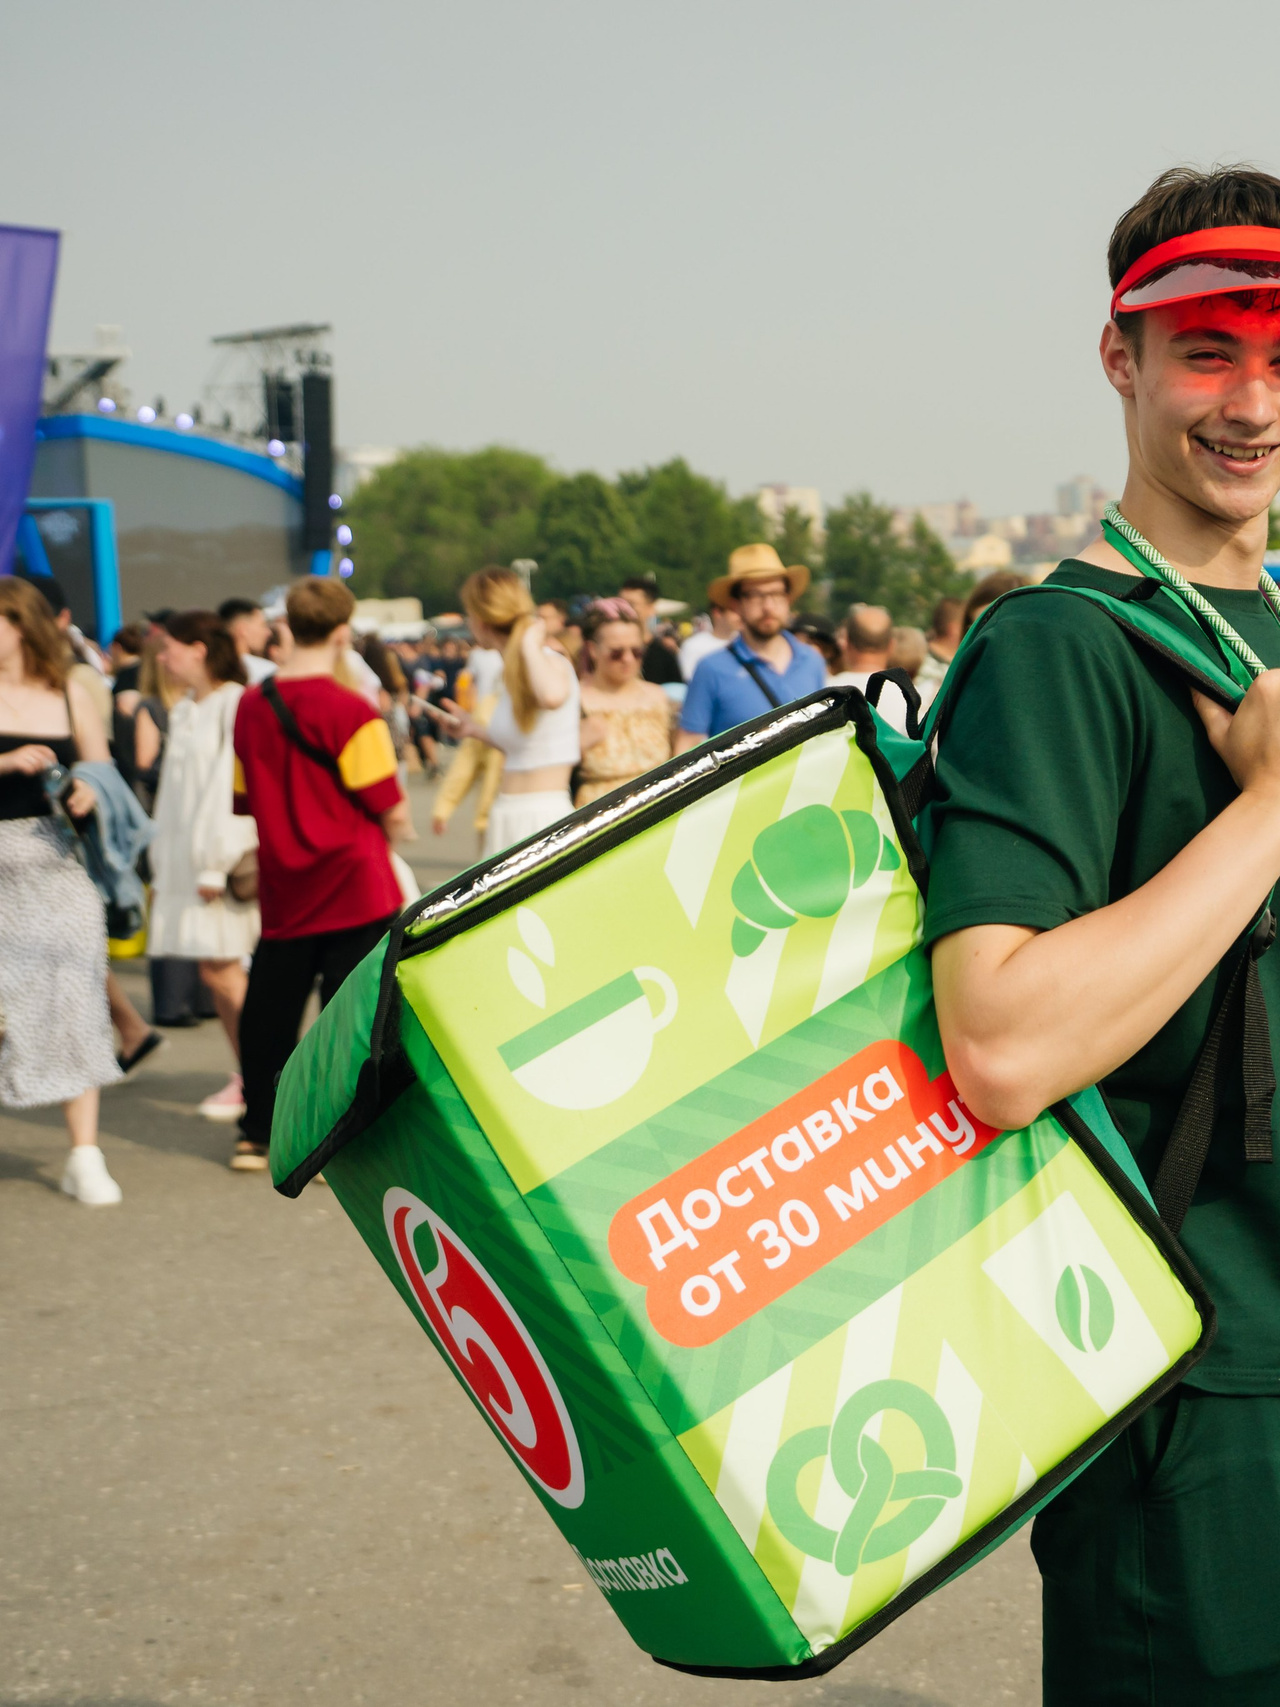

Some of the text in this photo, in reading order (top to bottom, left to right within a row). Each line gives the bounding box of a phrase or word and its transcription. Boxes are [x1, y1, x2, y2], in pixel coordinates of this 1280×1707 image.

[635, 1065, 905, 1271] Доставка
[679, 1094, 977, 1317] от 30 мину
